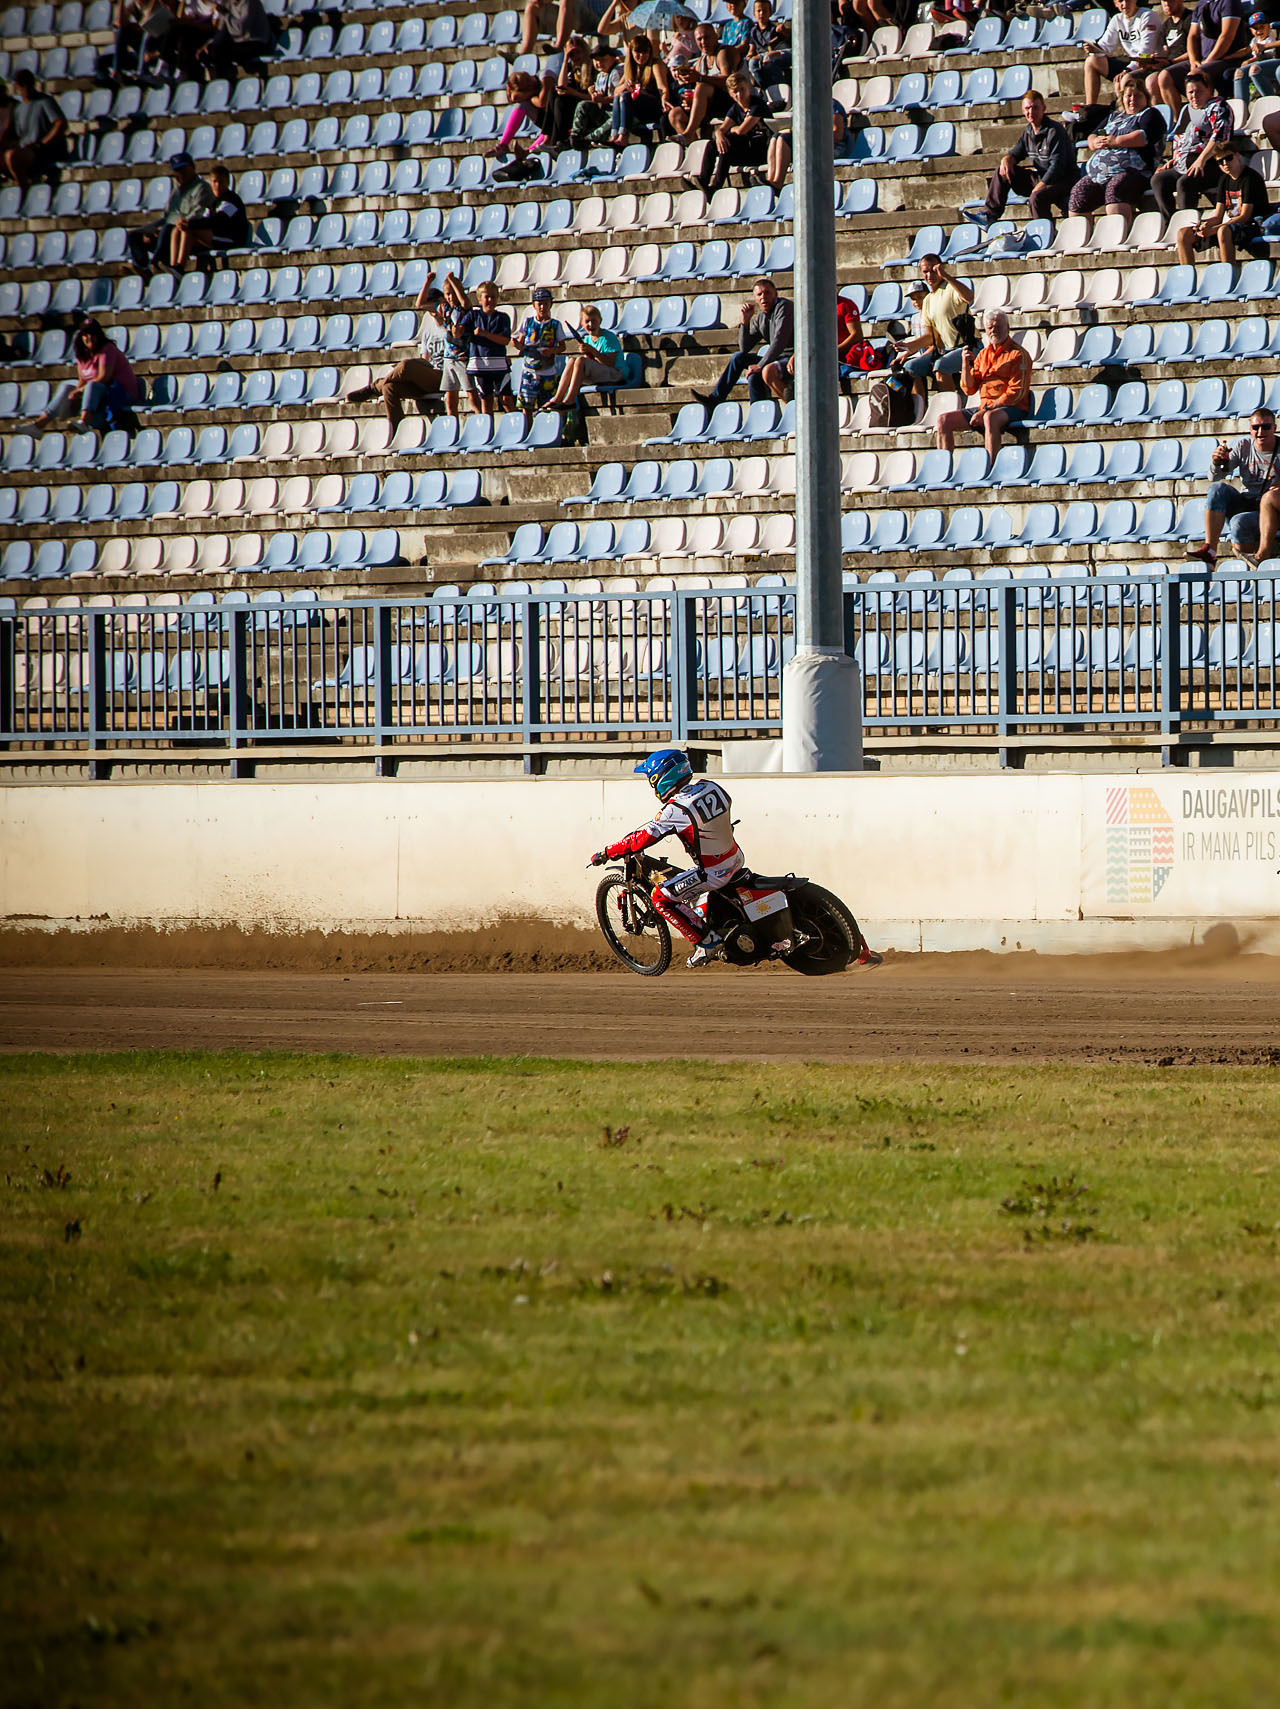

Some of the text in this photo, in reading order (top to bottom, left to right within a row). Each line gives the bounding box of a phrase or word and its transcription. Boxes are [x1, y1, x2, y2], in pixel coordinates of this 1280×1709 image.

[696, 791, 724, 821] 12
[1182, 831, 1276, 860] IR MANA PILS
